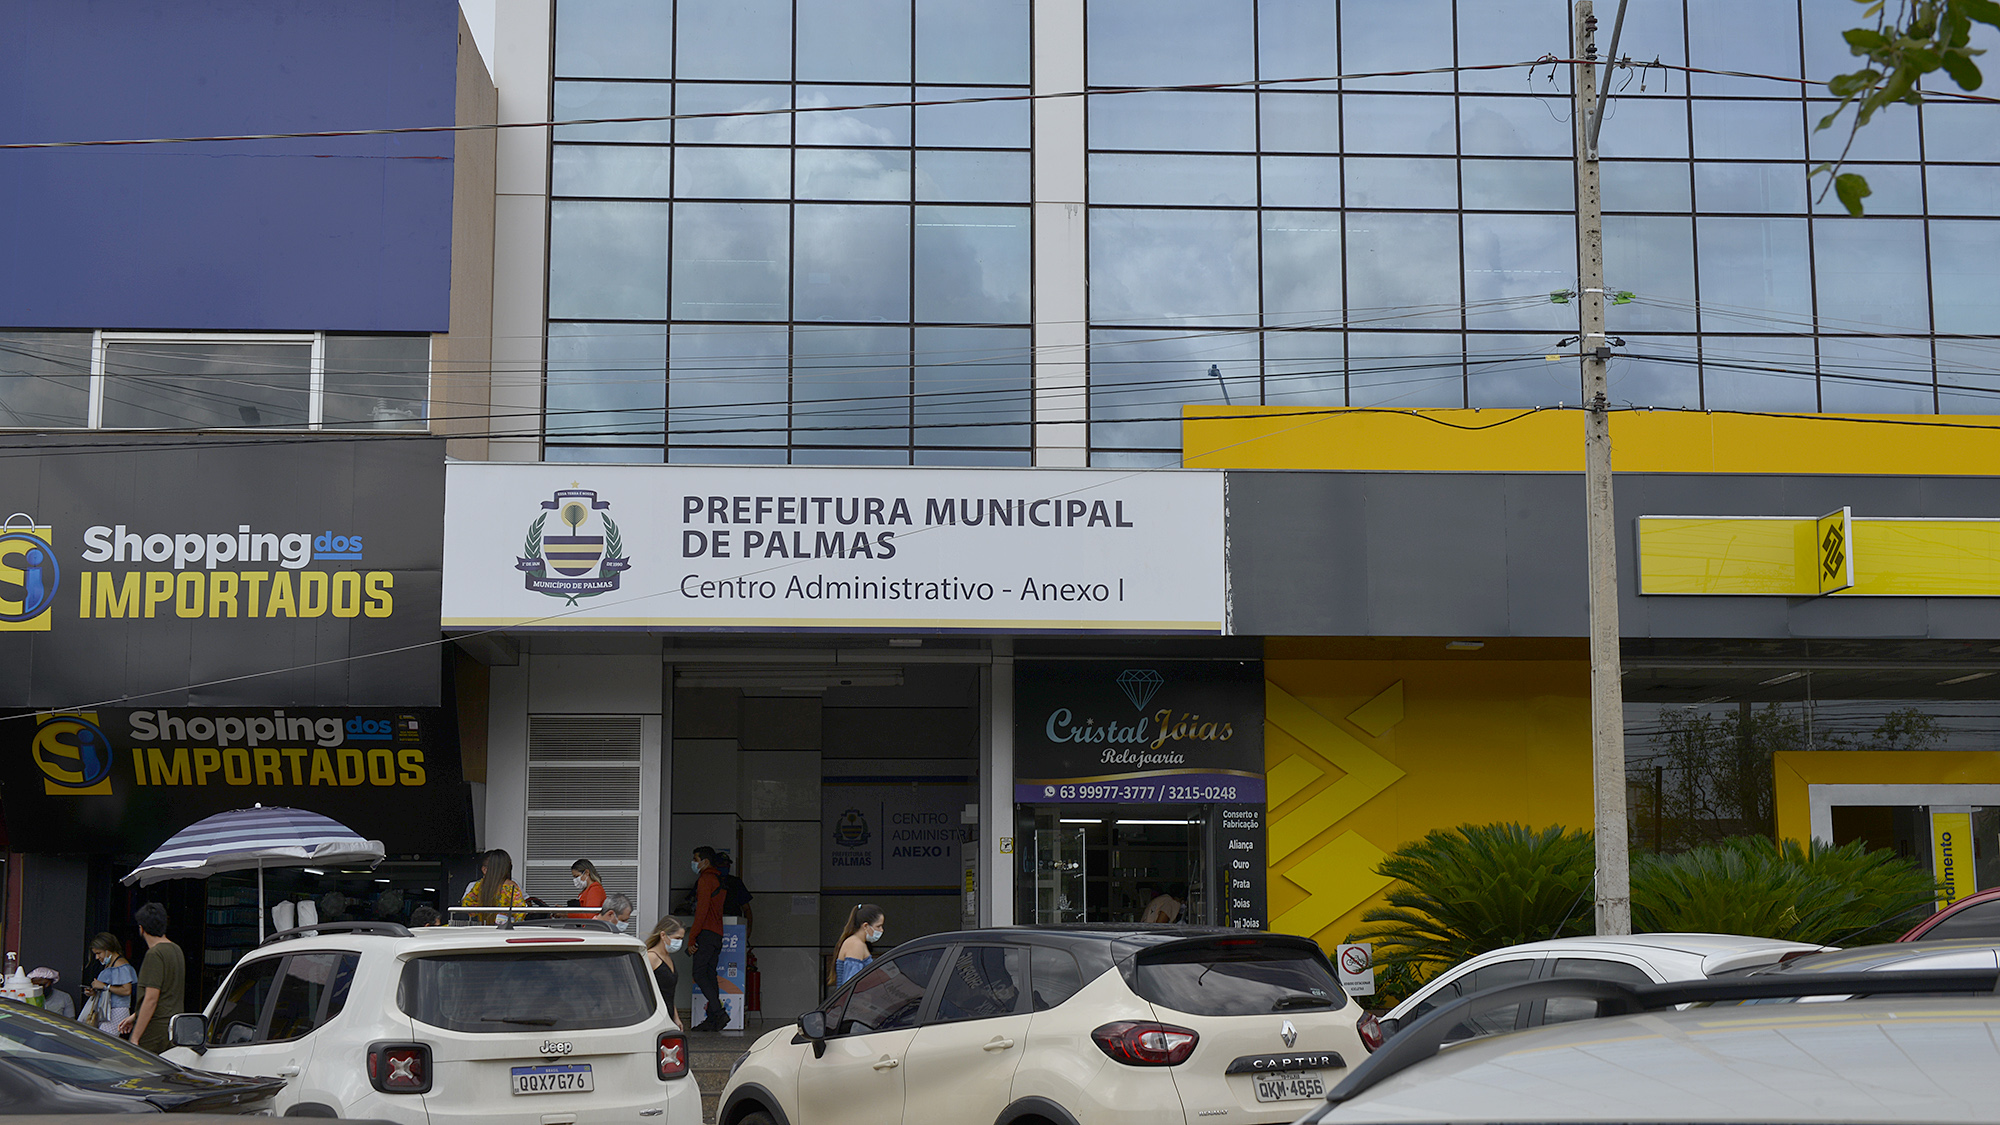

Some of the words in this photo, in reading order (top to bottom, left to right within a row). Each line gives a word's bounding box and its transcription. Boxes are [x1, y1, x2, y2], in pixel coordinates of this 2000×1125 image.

[683, 495, 913, 526] PREFEITURA
[925, 497, 1134, 528] MUNICIPAL
[81, 524, 312, 569] Shopping
[314, 530, 363, 553] dos
[682, 529, 730, 559] DE
[743, 530, 897, 560] PALMAS
[533, 580, 572, 589] MUNICÍPIO
[583, 581, 613, 589] PALMAS
[680, 574, 776, 600] Centro
[785, 574, 994, 602] Administrativo
[1020, 577, 1110, 602] Anexo
[79, 570, 394, 619] IMPORTADOS
[128, 710, 345, 747] Shopping
[345, 715, 393, 735] dos
[1045, 707, 1150, 744] Cristal
[1150, 709, 1233, 750] Jóias
[1100, 748, 1185, 768] Relojoaria
[131, 747, 427, 787] IMPORTADOS
[1059, 785, 1076, 799] 63
[1079, 785, 1155, 800] 99977-3777
[1159, 784, 1166, 801] /
[1168, 786, 1237, 800] 3215-0248
[892, 813, 949, 825] CENTRO
[1222, 810, 1253, 819] Conserto
[1253, 811, 1259, 819] e
[1222, 820, 1259, 830] Fabricação
[892, 829, 967, 841] ADMINISTR
[892, 846, 942, 857] ANEXO
[1228, 839, 1254, 852] Aliança
[832, 857, 872, 866] PALMAS
[1232, 859, 1250, 869] Ouro
[1940, 832, 1955, 905] ndimento
[1232, 879, 1251, 889] Prata
[1233, 898, 1251, 909] Joias
[1242, 918, 1260, 929] Joias
[721, 934, 739, 948] CÊ
[540, 1040, 573, 1054] Jeep
[1253, 1056, 1331, 1069] CAPTUR
[519, 1073, 585, 1092] QQX7G76
